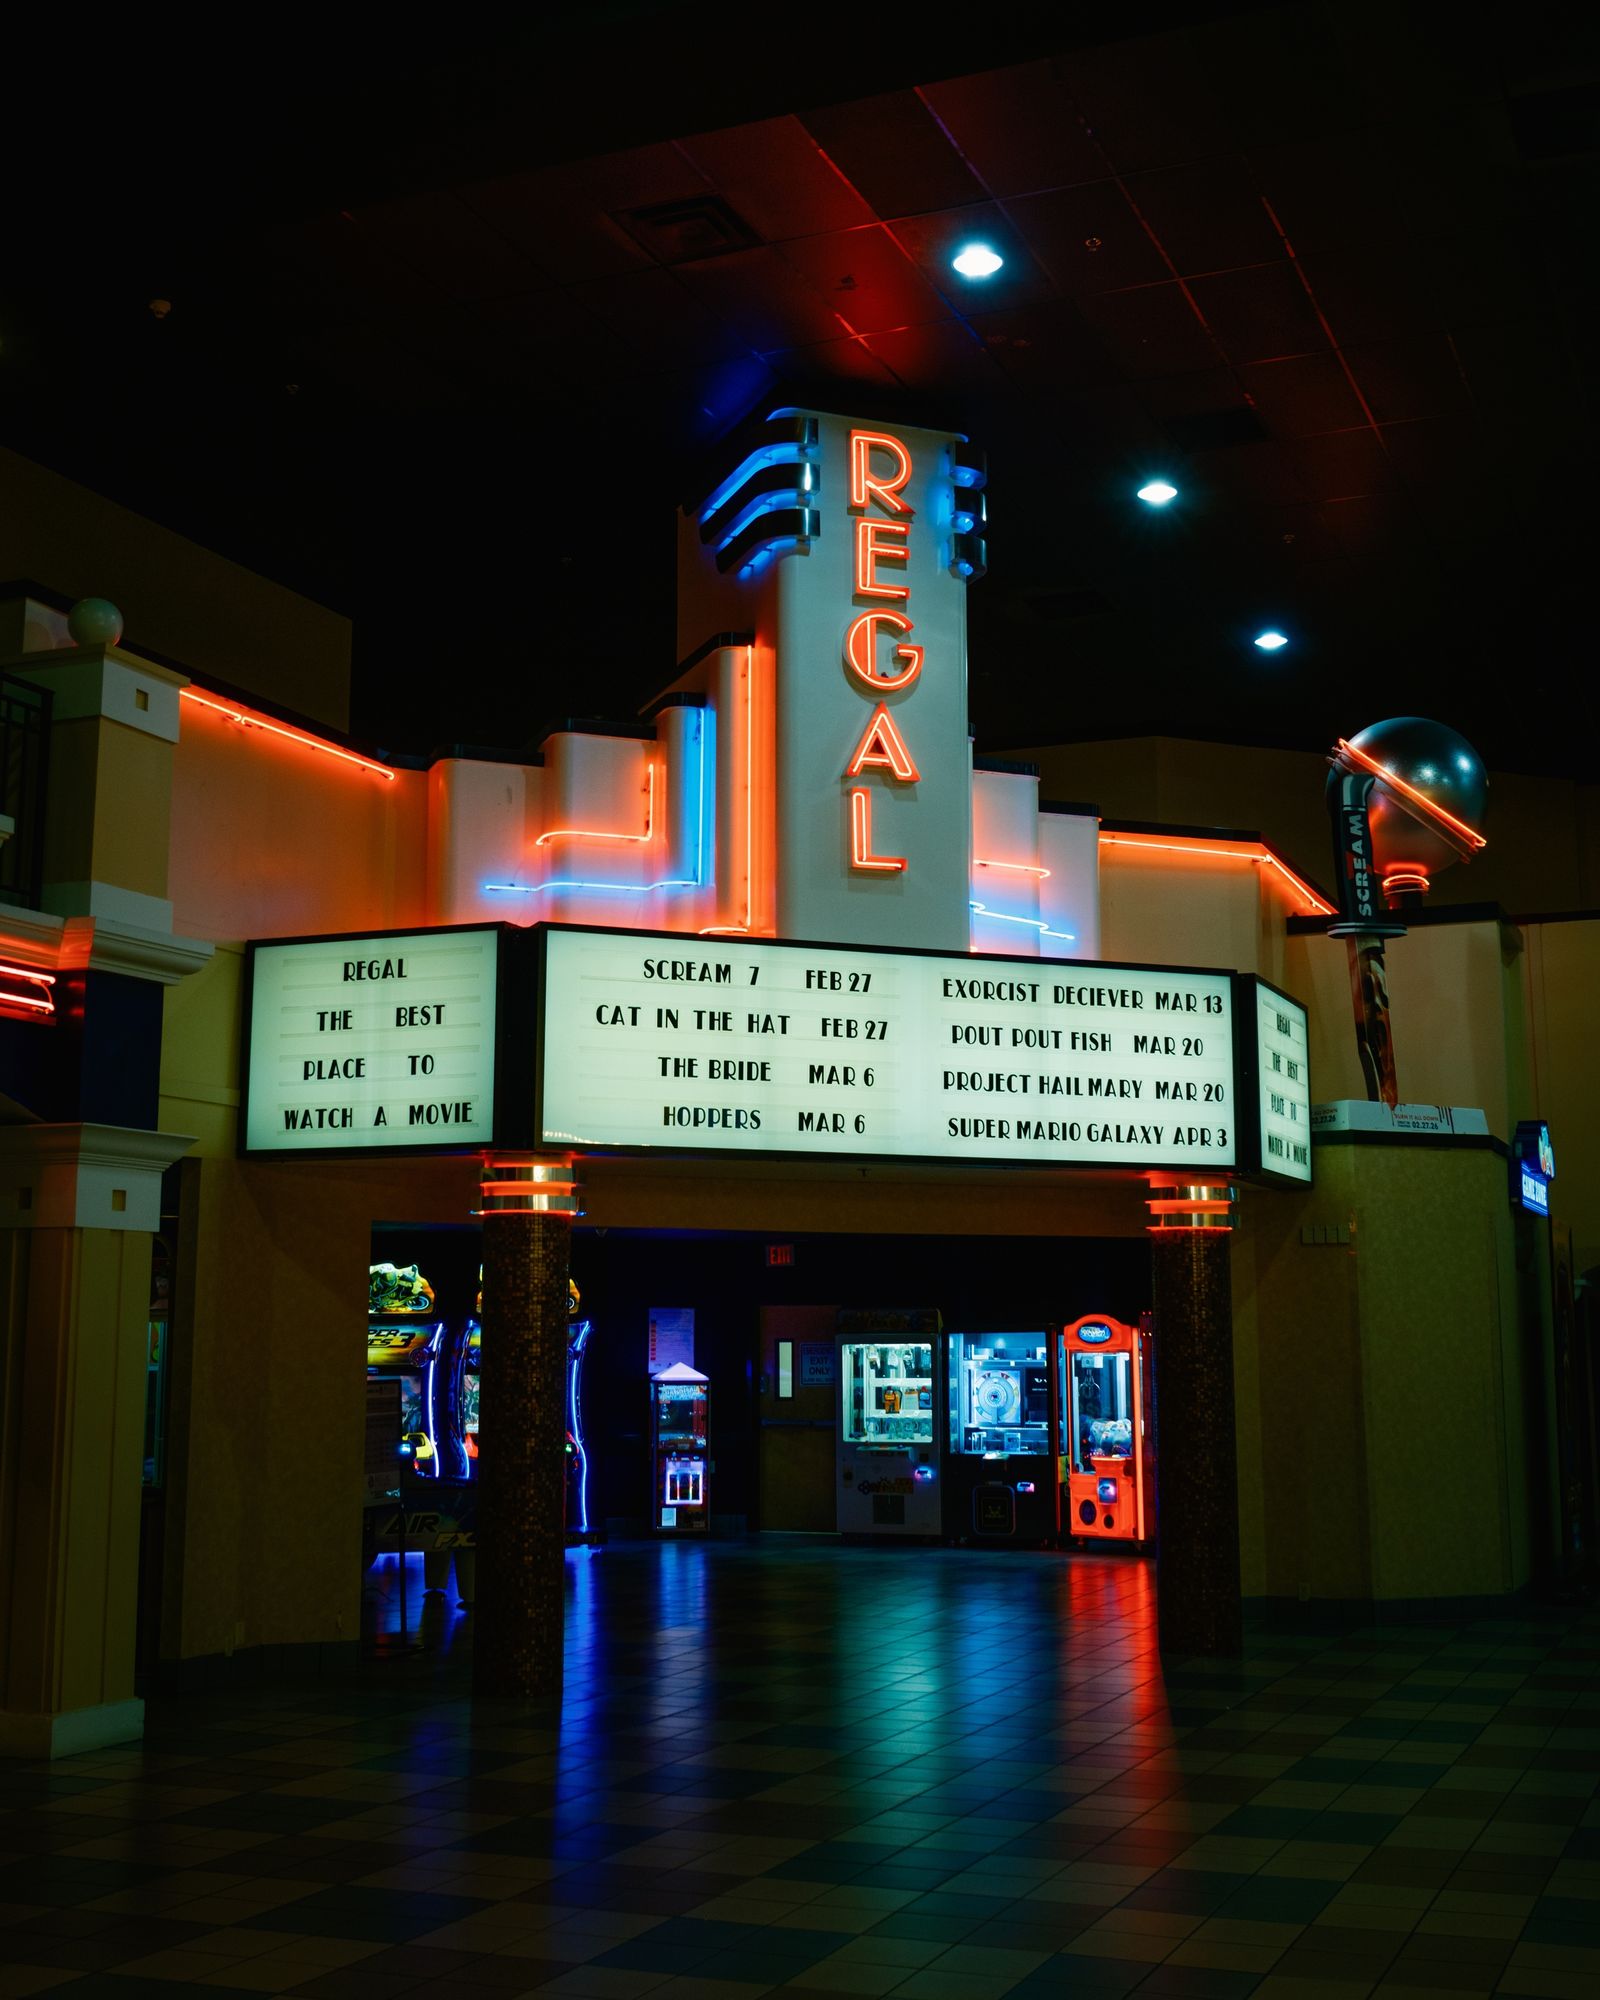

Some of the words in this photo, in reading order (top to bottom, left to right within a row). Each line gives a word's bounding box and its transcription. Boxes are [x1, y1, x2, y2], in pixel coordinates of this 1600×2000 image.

[842, 429, 924, 874] REGAL
[1348, 814, 1372, 917] SCREAM
[343, 958, 408, 982] REGAL
[643, 958, 731, 984] SCREAM
[749, 966, 760, 986] 7
[805, 969, 842, 991] FEB
[848, 972, 872, 993] 27
[942, 978, 1040, 1003] EXORCIST
[1053, 985, 1143, 1010] DECIEVER
[1155, 991, 1197, 1013] MAR
[1203, 994, 1223, 1014] 13
[316, 1009, 353, 1032] THE
[395, 1004, 446, 1028] BEST
[595, 1004, 642, 1027] CAT
[656, 1008, 679, 1029] IN
[693, 1009, 733, 1032] THE
[747, 1013, 791, 1035] HAT
[821, 1017, 858, 1039] FEB
[864, 1020, 888, 1041] 27
[951, 1024, 1003, 1046] POUT
[1011, 1028, 1063, 1049] POUT
[1070, 1031, 1112, 1052] FISH
[1133, 1034, 1176, 1056] MAR
[1182, 1037, 1204, 1057] 20
[303, 1057, 366, 1081] PLACE
[407, 1054, 435, 1076] TO
[657, 1056, 699, 1078] THE
[708, 1059, 771, 1082] BRIDE
[808, 1064, 856, 1087] MAR
[863, 1067, 875, 1087] 6
[943, 1070, 1031, 1094] PROJECT
[1155, 1081, 1197, 1102] MAR
[1203, 1083, 1224, 1103] 20
[283, 1107, 353, 1131] WATCH
[373, 1105, 388, 1127] A
[408, 1101, 474, 1126] MOVIE
[663, 1106, 761, 1130] HOPPERS
[798, 1111, 845, 1134] MAR
[854, 1114, 865, 1134] 6
[948, 1117, 1010, 1140] SUPER
[1016, 1120, 1081, 1142] MARIO
[1086, 1123, 1164, 1145] GALAXY
[1172, 1126, 1212, 1147] APR
[1217, 1128, 1228, 1148] 3
[769, 1247, 792, 1265] EXIT
[384, 1513, 440, 1535] AIR
